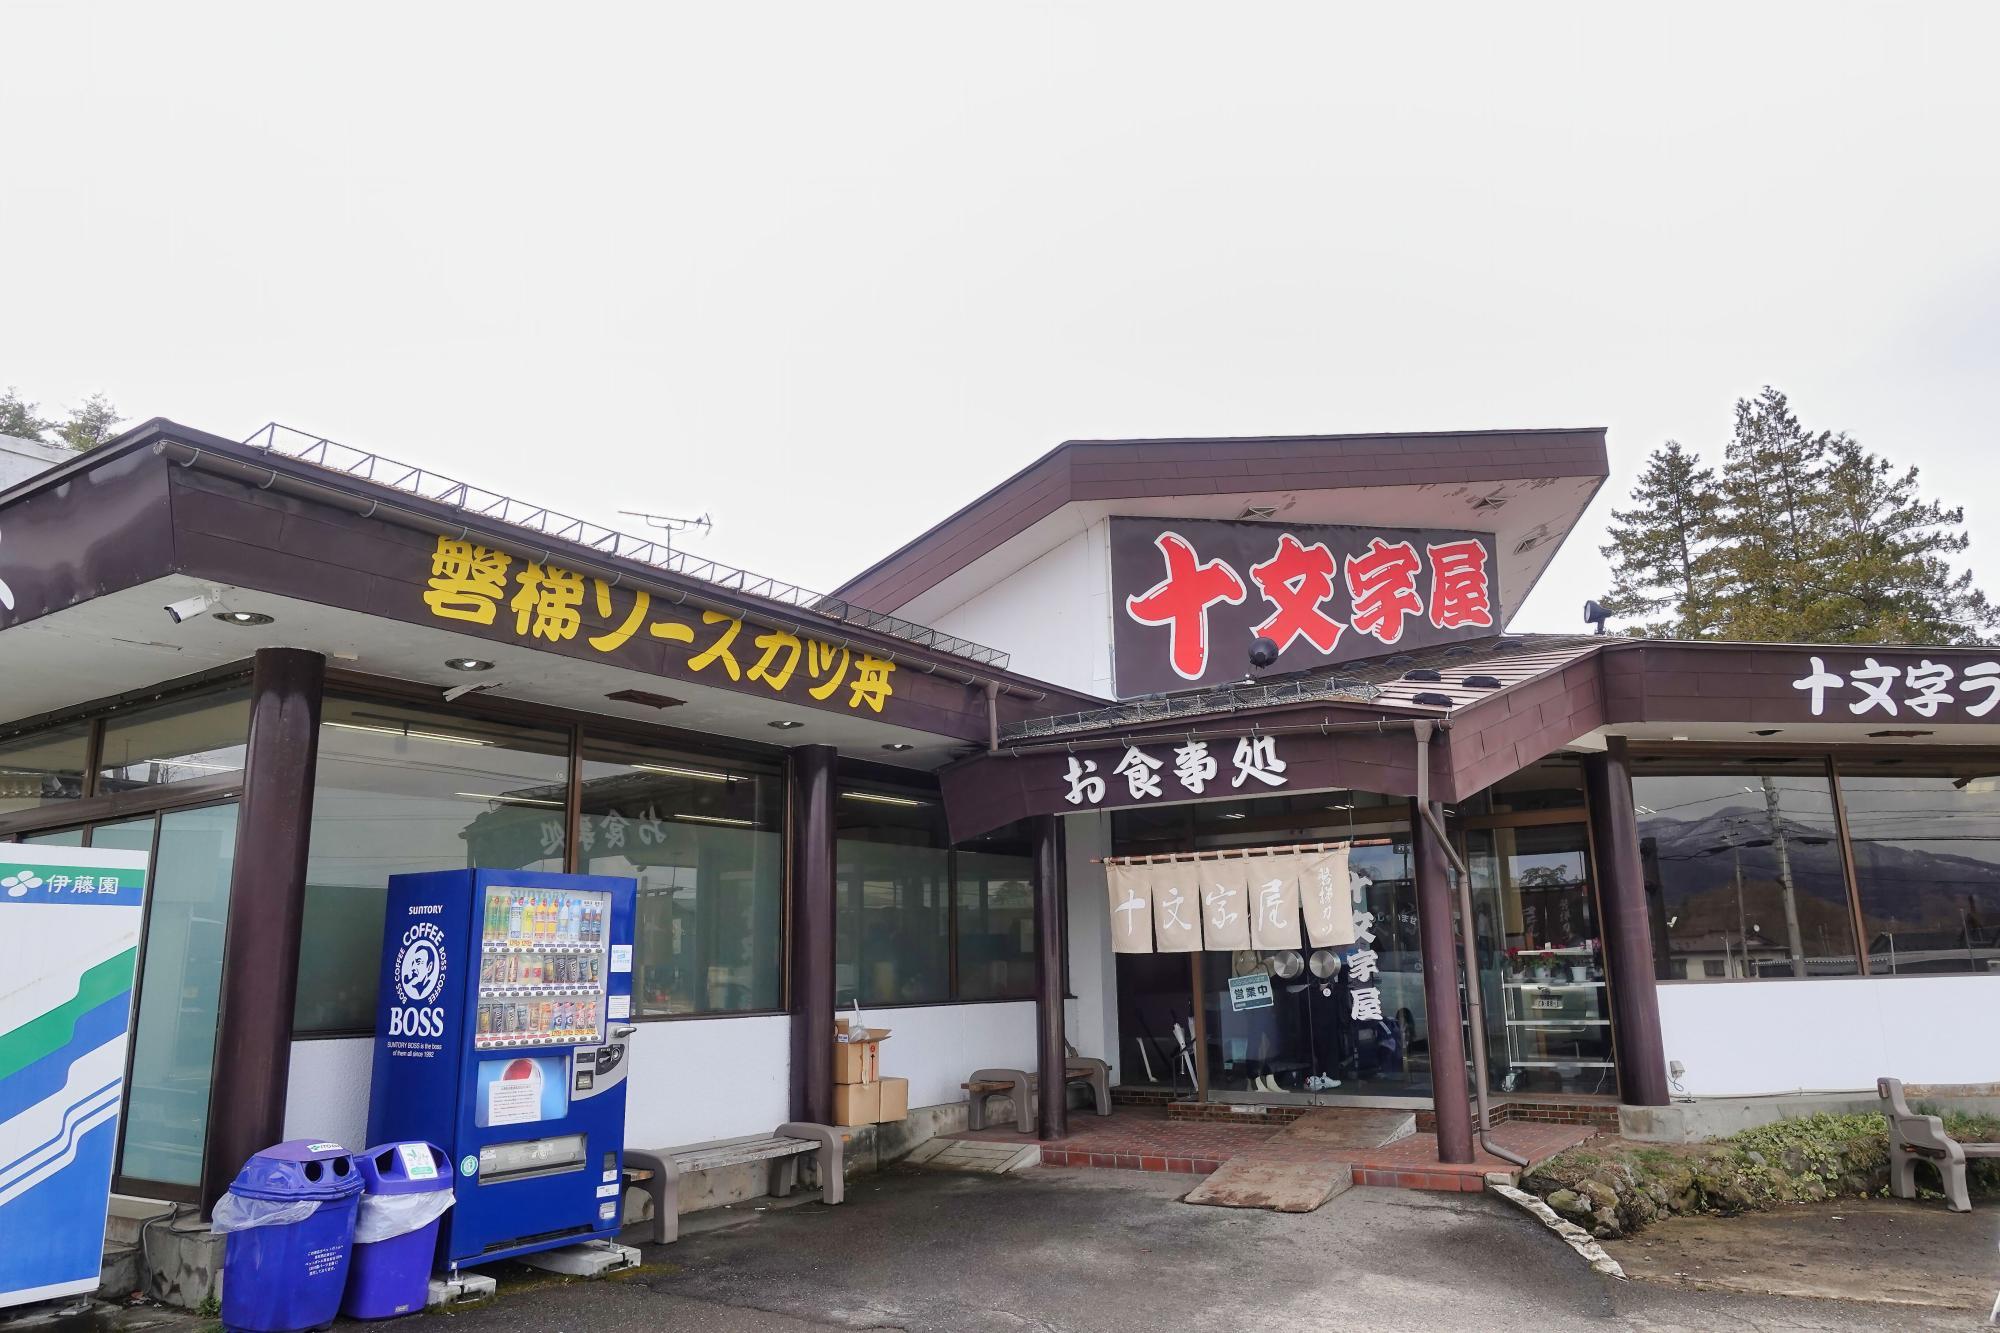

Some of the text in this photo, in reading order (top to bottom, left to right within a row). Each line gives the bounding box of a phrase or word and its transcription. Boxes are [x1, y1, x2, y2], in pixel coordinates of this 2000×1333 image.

[423, 535, 897, 713] 磐梯ソースカツ丼
[1126, 531, 1494, 680] 十文字屋
[1792, 656, 2000, 718] 十文字ラ
[1063, 736, 1288, 805] お食事処
[46, 874, 119, 894] 伊藤園
[408, 905, 443, 915] SUNTORY
[1115, 879, 1288, 938] 十文字屋
[394, 947, 405, 982] COFFEE
[402, 923, 445, 947] COFFEE
[1347, 870, 1383, 1021] 十文字屋
[428, 946, 447, 1005] BOSS COFFEE
[1235, 985, 1268, 1000] 営業中
[389, 1007, 444, 1037] BOSS
